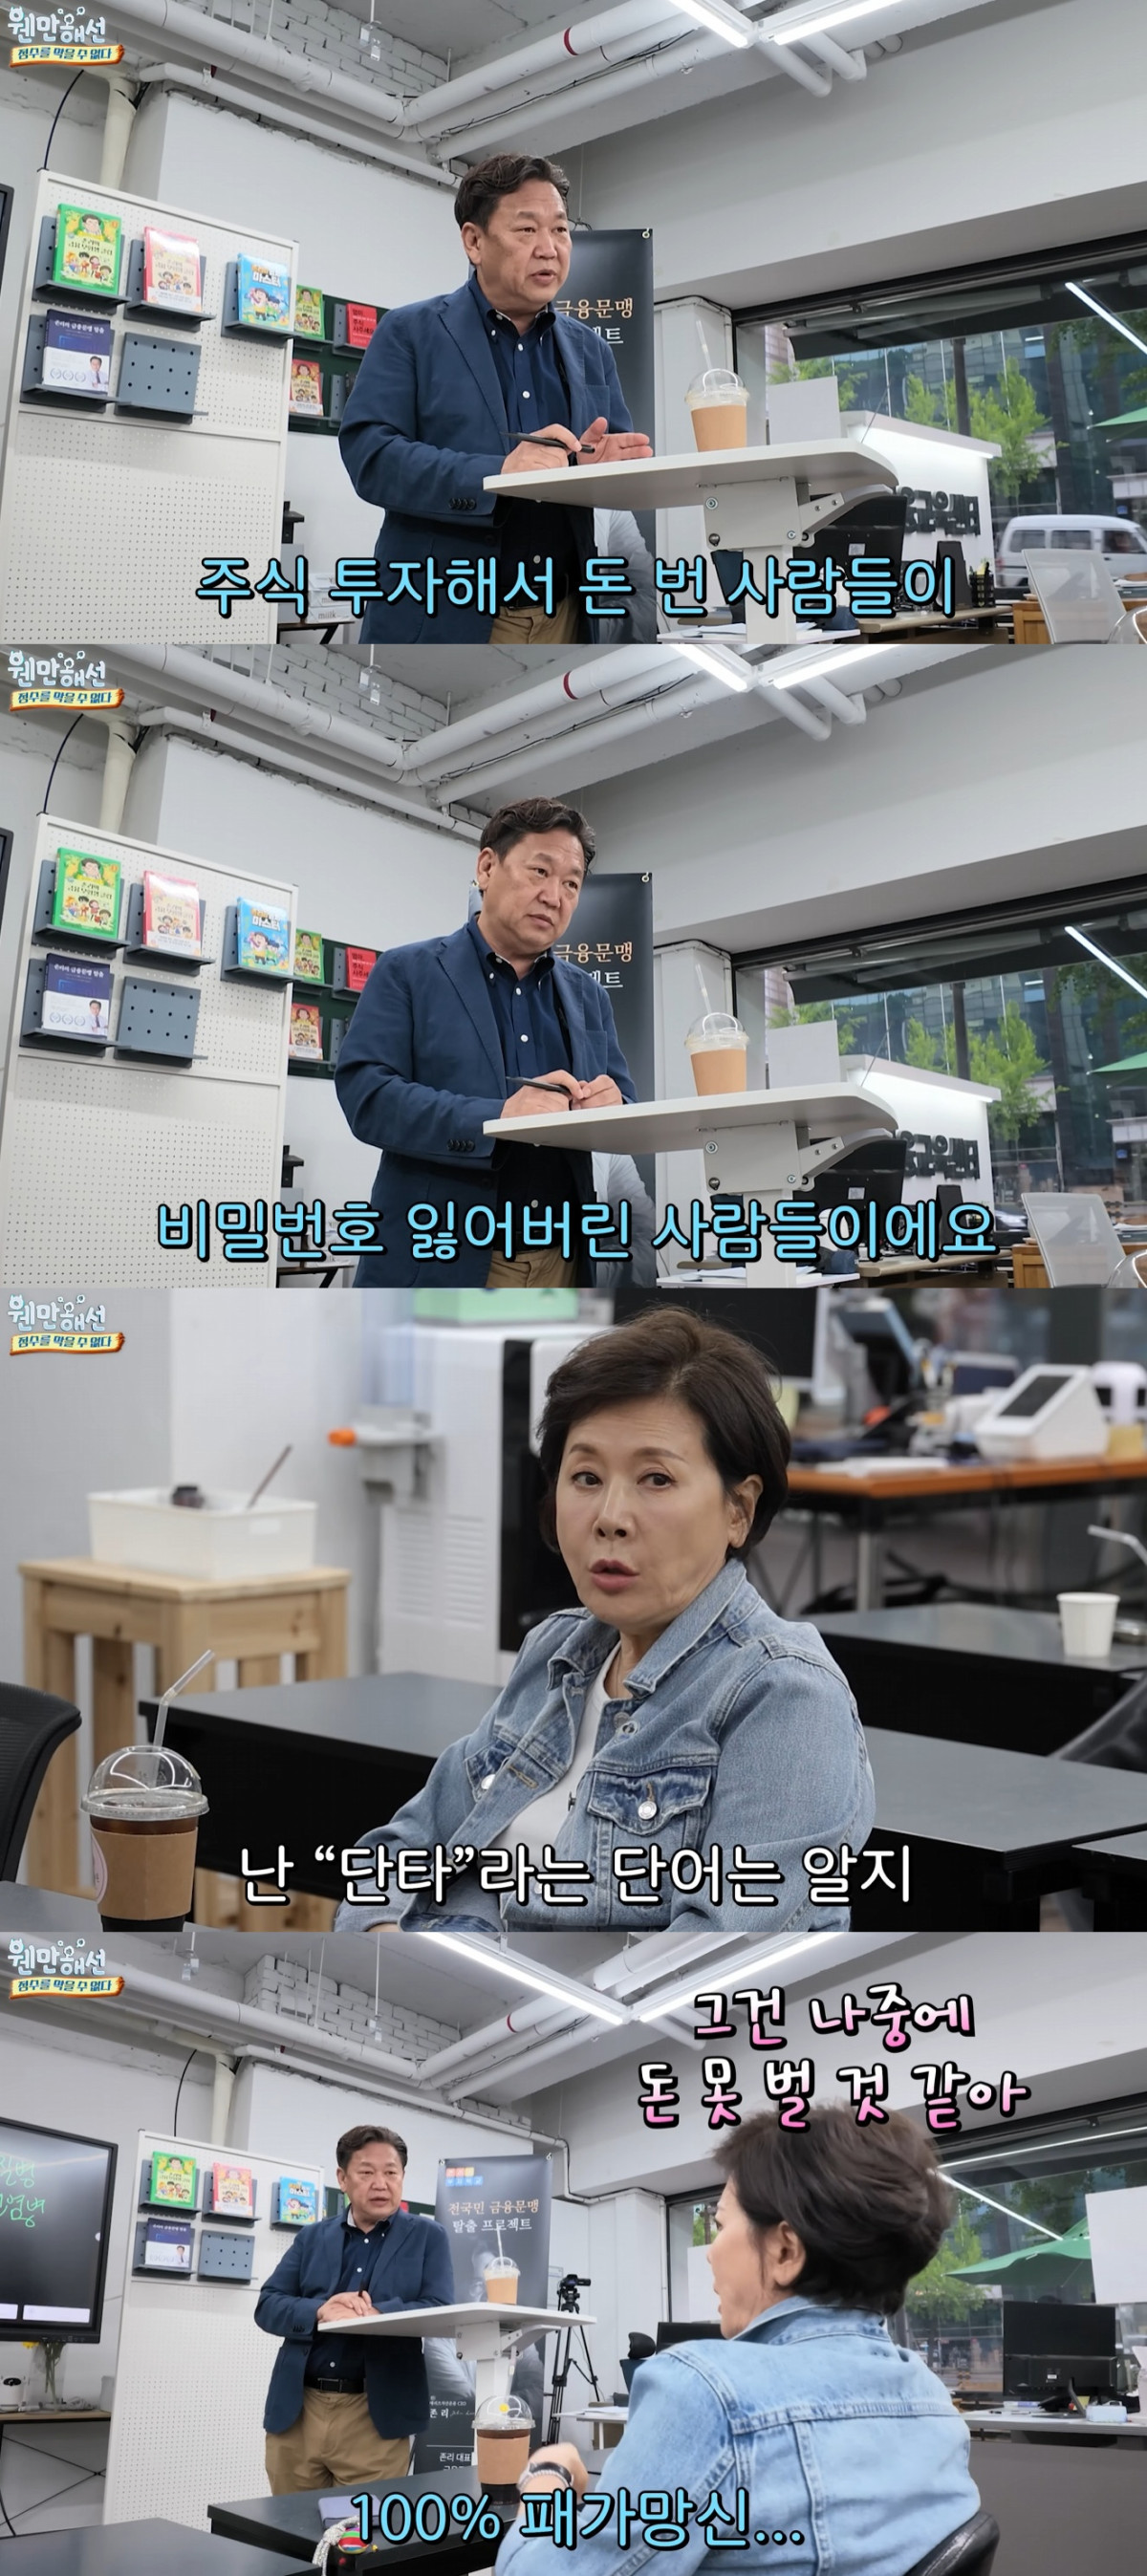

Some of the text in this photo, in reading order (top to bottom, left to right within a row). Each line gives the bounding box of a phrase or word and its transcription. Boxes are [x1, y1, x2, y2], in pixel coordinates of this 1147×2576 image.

[449, 2199, 539, 2216] 전국민 금융문맹
[452, 2218, 532, 2234] 탈출 프로젝트
